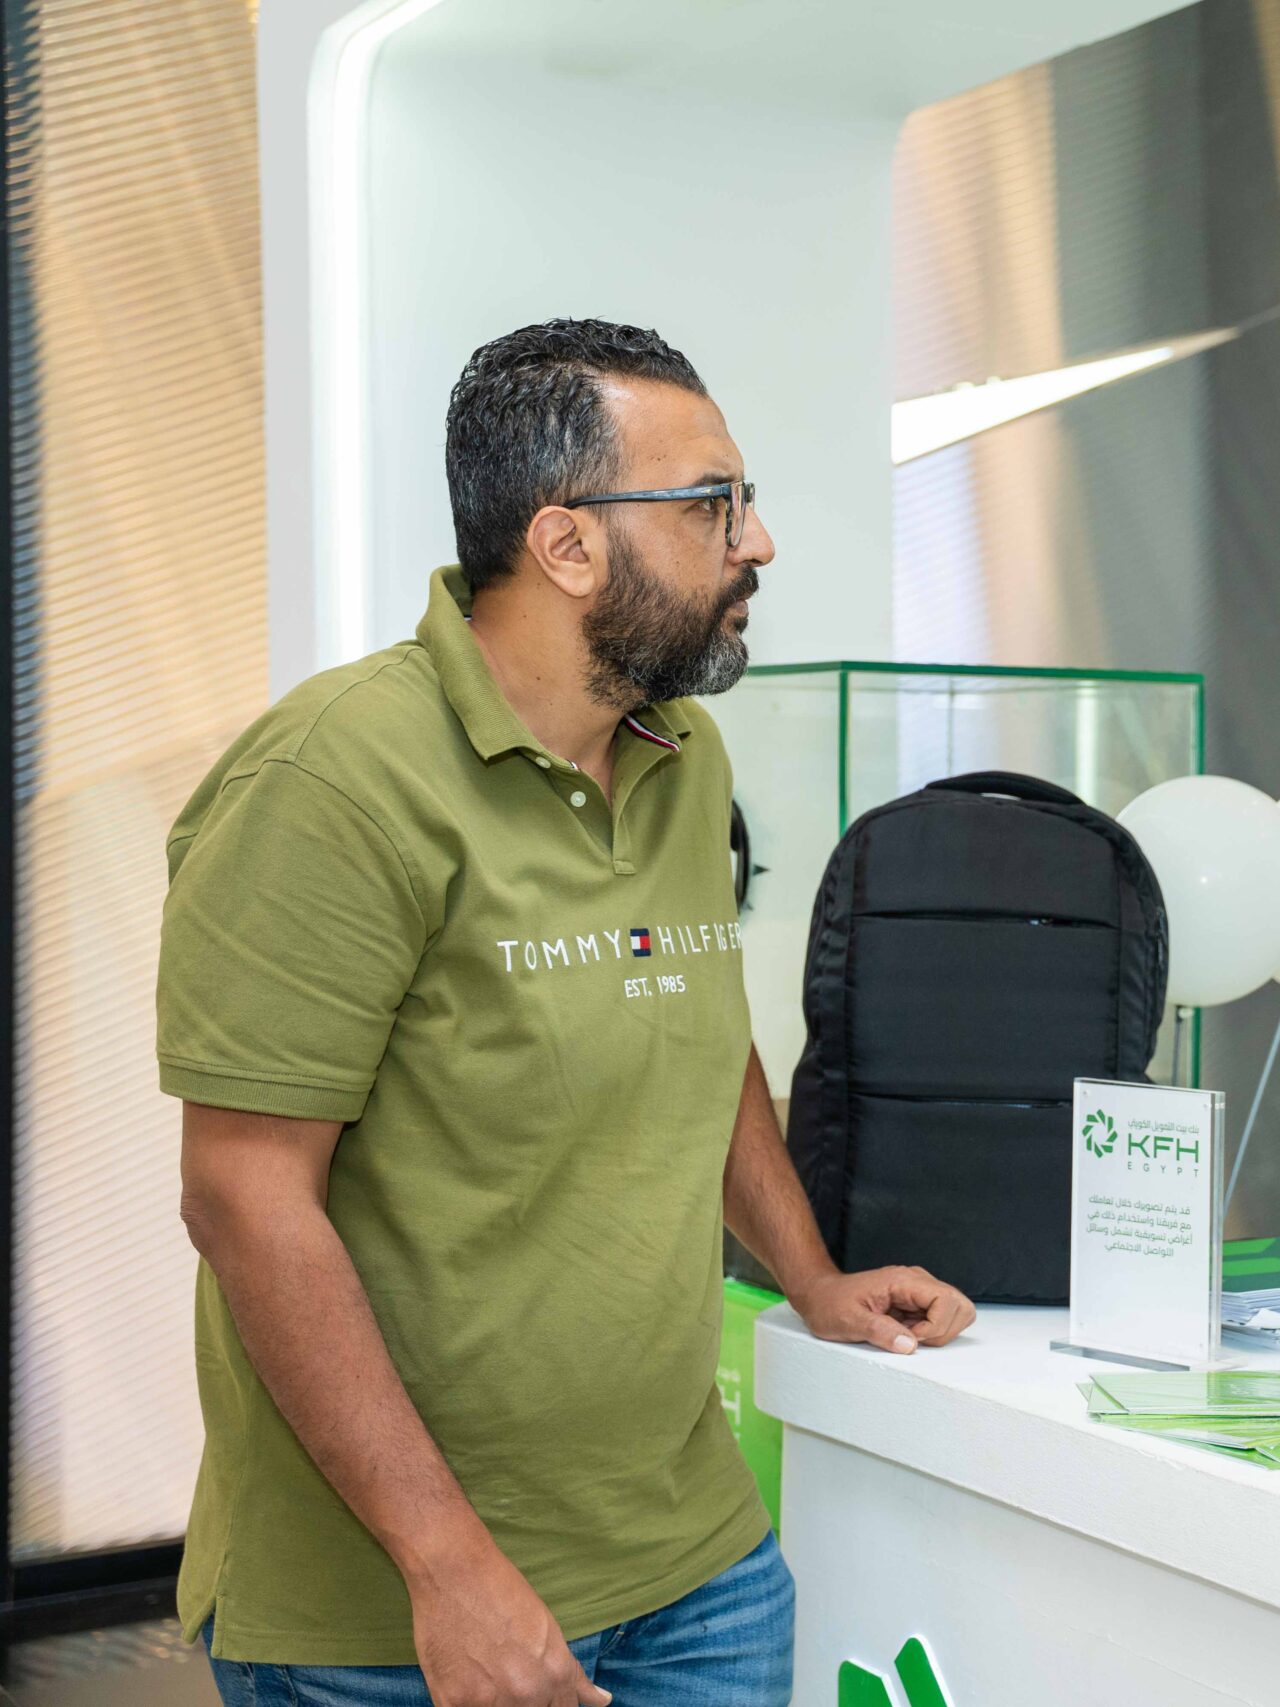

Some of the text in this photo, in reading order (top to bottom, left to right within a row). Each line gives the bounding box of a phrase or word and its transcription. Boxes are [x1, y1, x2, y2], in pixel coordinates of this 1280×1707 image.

[497, 921, 742, 972] TOMMY HILFIGER
[624, 975, 686, 998] EST. 1985
[1128, 1133, 1199, 1163] KFH
[1127, 1161, 1199, 1177] EGYPT
